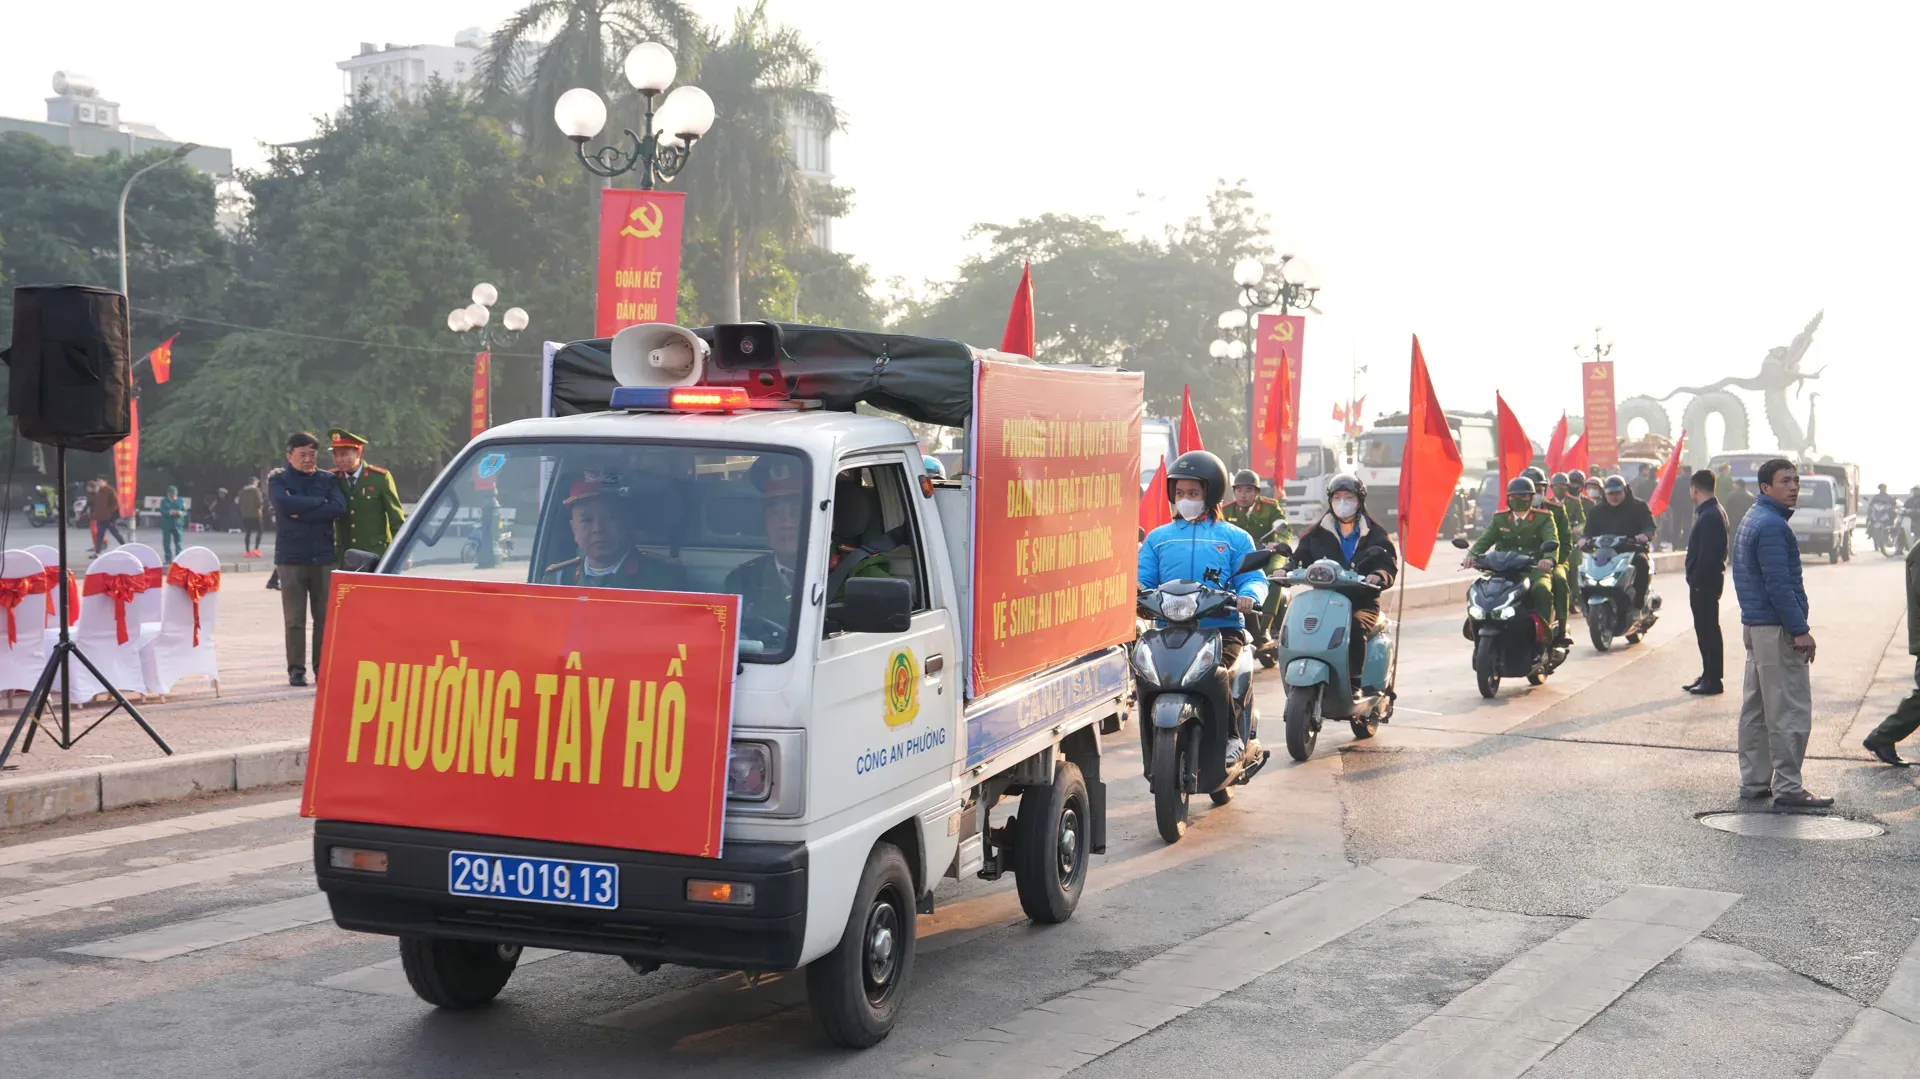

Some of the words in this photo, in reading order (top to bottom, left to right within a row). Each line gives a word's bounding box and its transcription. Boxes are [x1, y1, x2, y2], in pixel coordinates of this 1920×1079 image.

[615, 267, 641, 289] ĐOÀN
[643, 265, 662, 289] KẾT
[616, 299, 637, 320] DÂN
[638, 297, 658, 321] CHỦ
[1049, 413, 1066, 457] TÂY
[1007, 466, 1033, 518] ĐẢM
[1036, 466, 1055, 516] BẢO
[1058, 470, 1080, 521] TRẬT
[1082, 472, 1094, 518] TỰ
[1095, 468, 1106, 508] ĐÔ
[1016, 530, 1030, 584] VỆ
[1032, 535, 1056, 574] SINH
[1058, 526, 1077, 569] MÔI
[993, 592, 1008, 648] VỆ
[1010, 595, 1036, 637] SINH
[1037, 592, 1053, 630] AN
[1054, 580, 1078, 625] TOÀN
[1080, 577, 1103, 623] THỰC
[1103, 560, 1128, 612] PHẨM
[345, 639, 522, 778] PHƯỜNG
[533, 651, 615, 785] TÂY
[622, 643, 689, 793] HỒ
[856, 747, 887, 775] CÔNG
[889, 741, 904, 763] AN
[906, 726, 946, 758] PHƯỜNG
[453, 855, 613, 905] 29A-019.13
